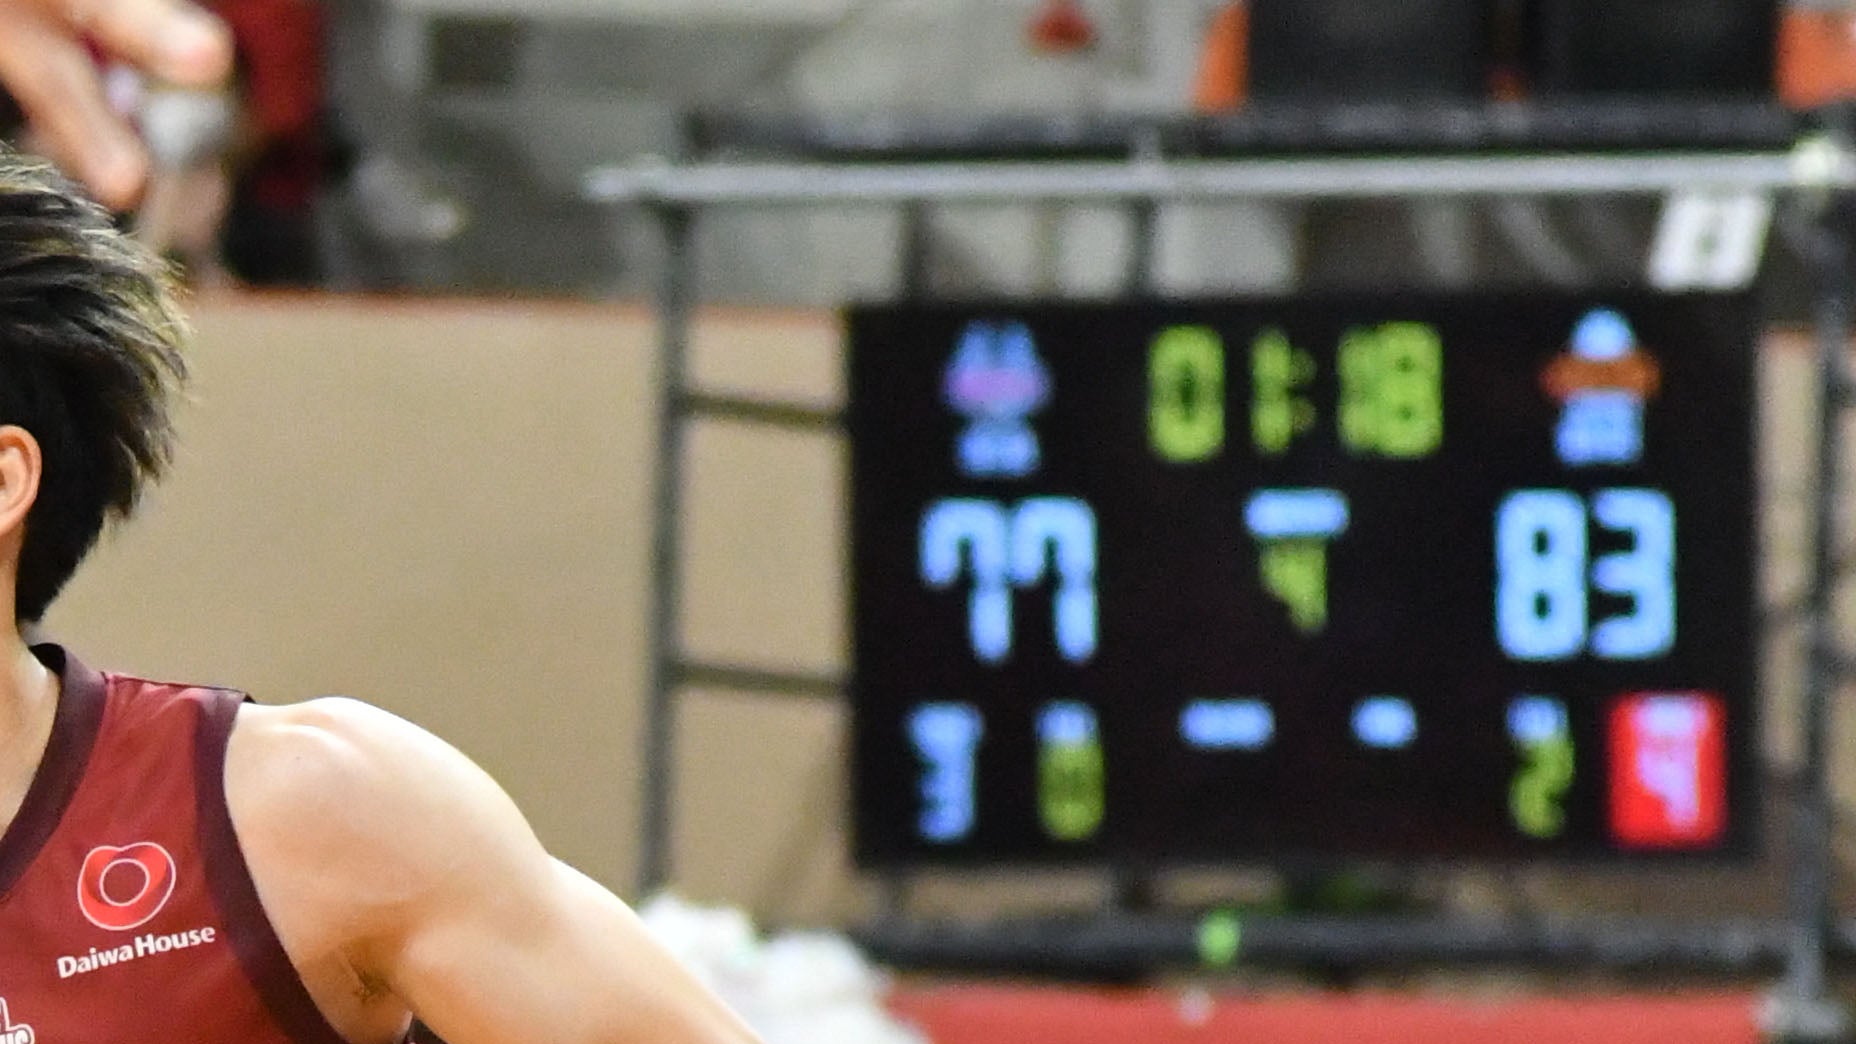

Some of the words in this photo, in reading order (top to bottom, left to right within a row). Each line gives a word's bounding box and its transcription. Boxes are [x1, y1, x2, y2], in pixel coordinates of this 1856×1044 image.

[1147, 324, 1445, 462] 01:18
[919, 496, 1099, 662] 77
[1494, 488, 1677, 660] 83
[56, 947, 134, 979] Daiwa
[134, 926, 216, 957] House
